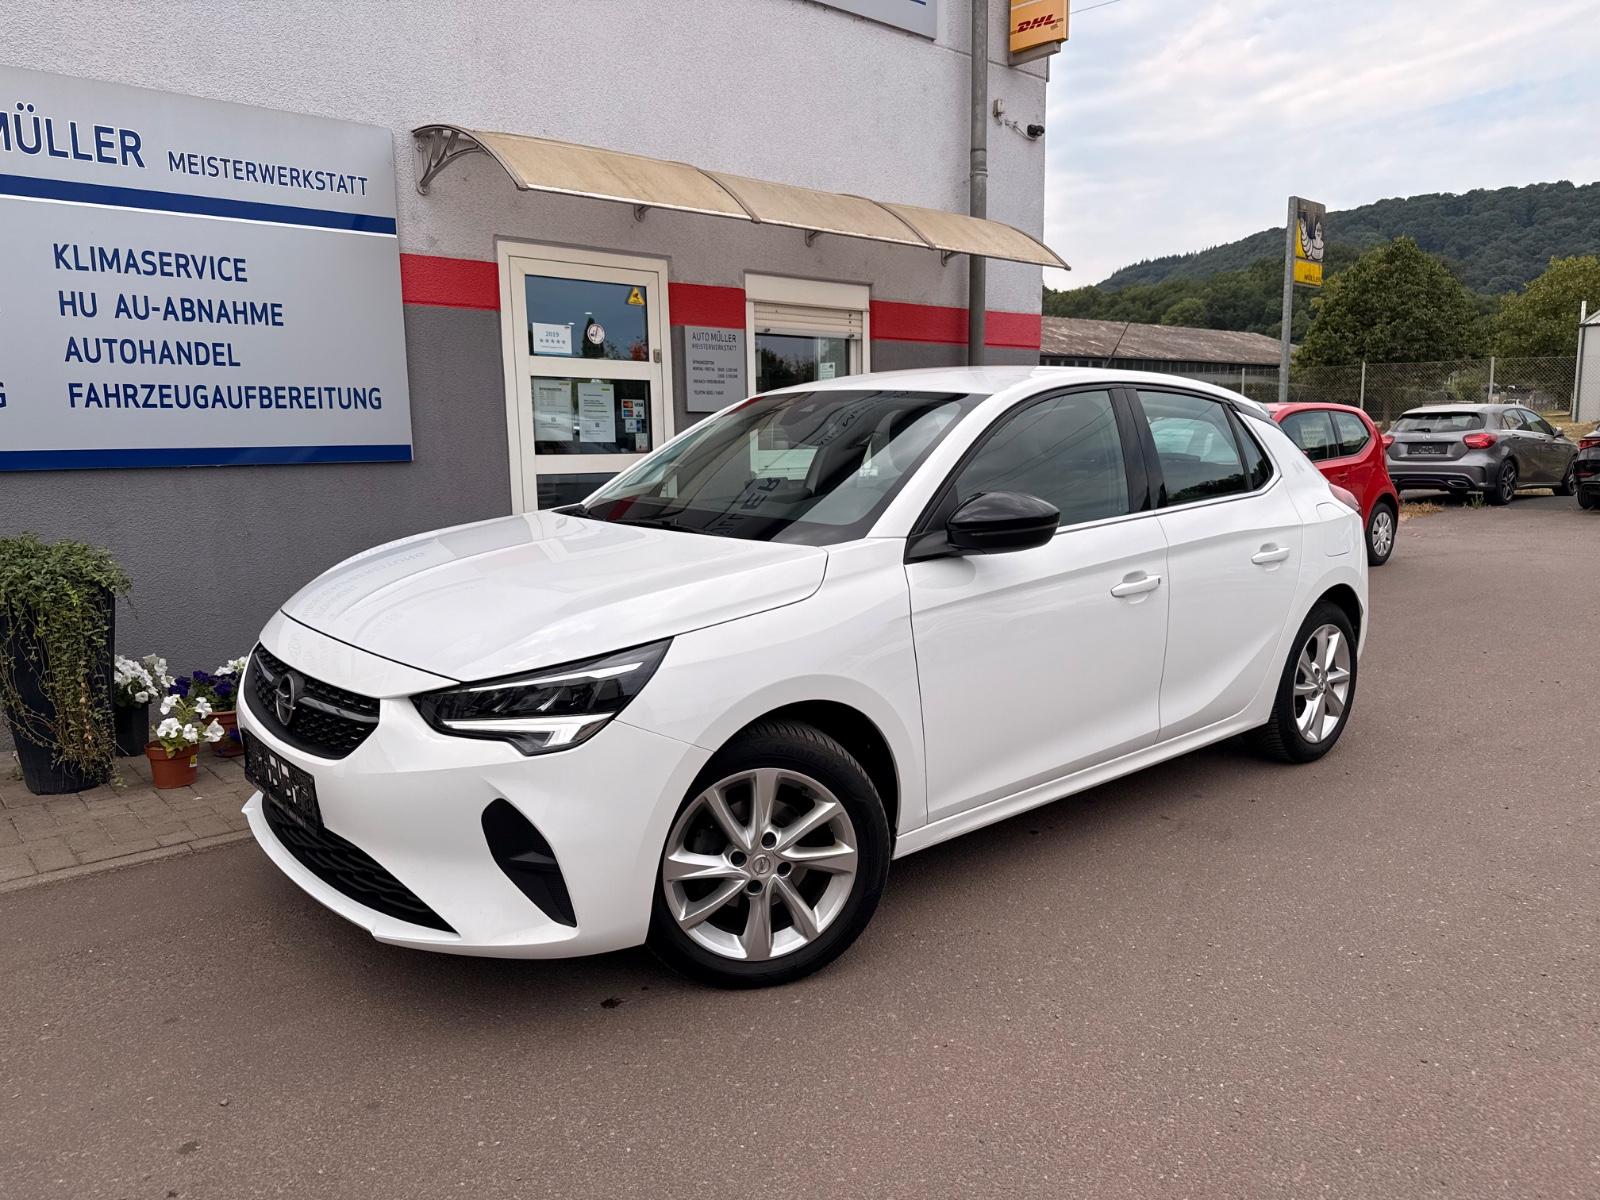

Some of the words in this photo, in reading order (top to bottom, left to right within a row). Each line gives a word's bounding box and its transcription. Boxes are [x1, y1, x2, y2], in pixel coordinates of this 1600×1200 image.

[1017, 14, 1056, 33] DHL
[168, 151, 368, 196] MEISTERWERKSTATT
[53, 243, 249, 283] KLIMASERVICE
[58, 290, 98, 317] HU
[114, 293, 284, 327] AU-ABNAHME
[64, 336, 241, 367] AUTOHANDEL
[692, 331, 710, 342] AUTO
[711, 330, 737, 343] MÜLLER
[67, 382, 383, 411] FAHRZEUGAUFBEREITUNG
